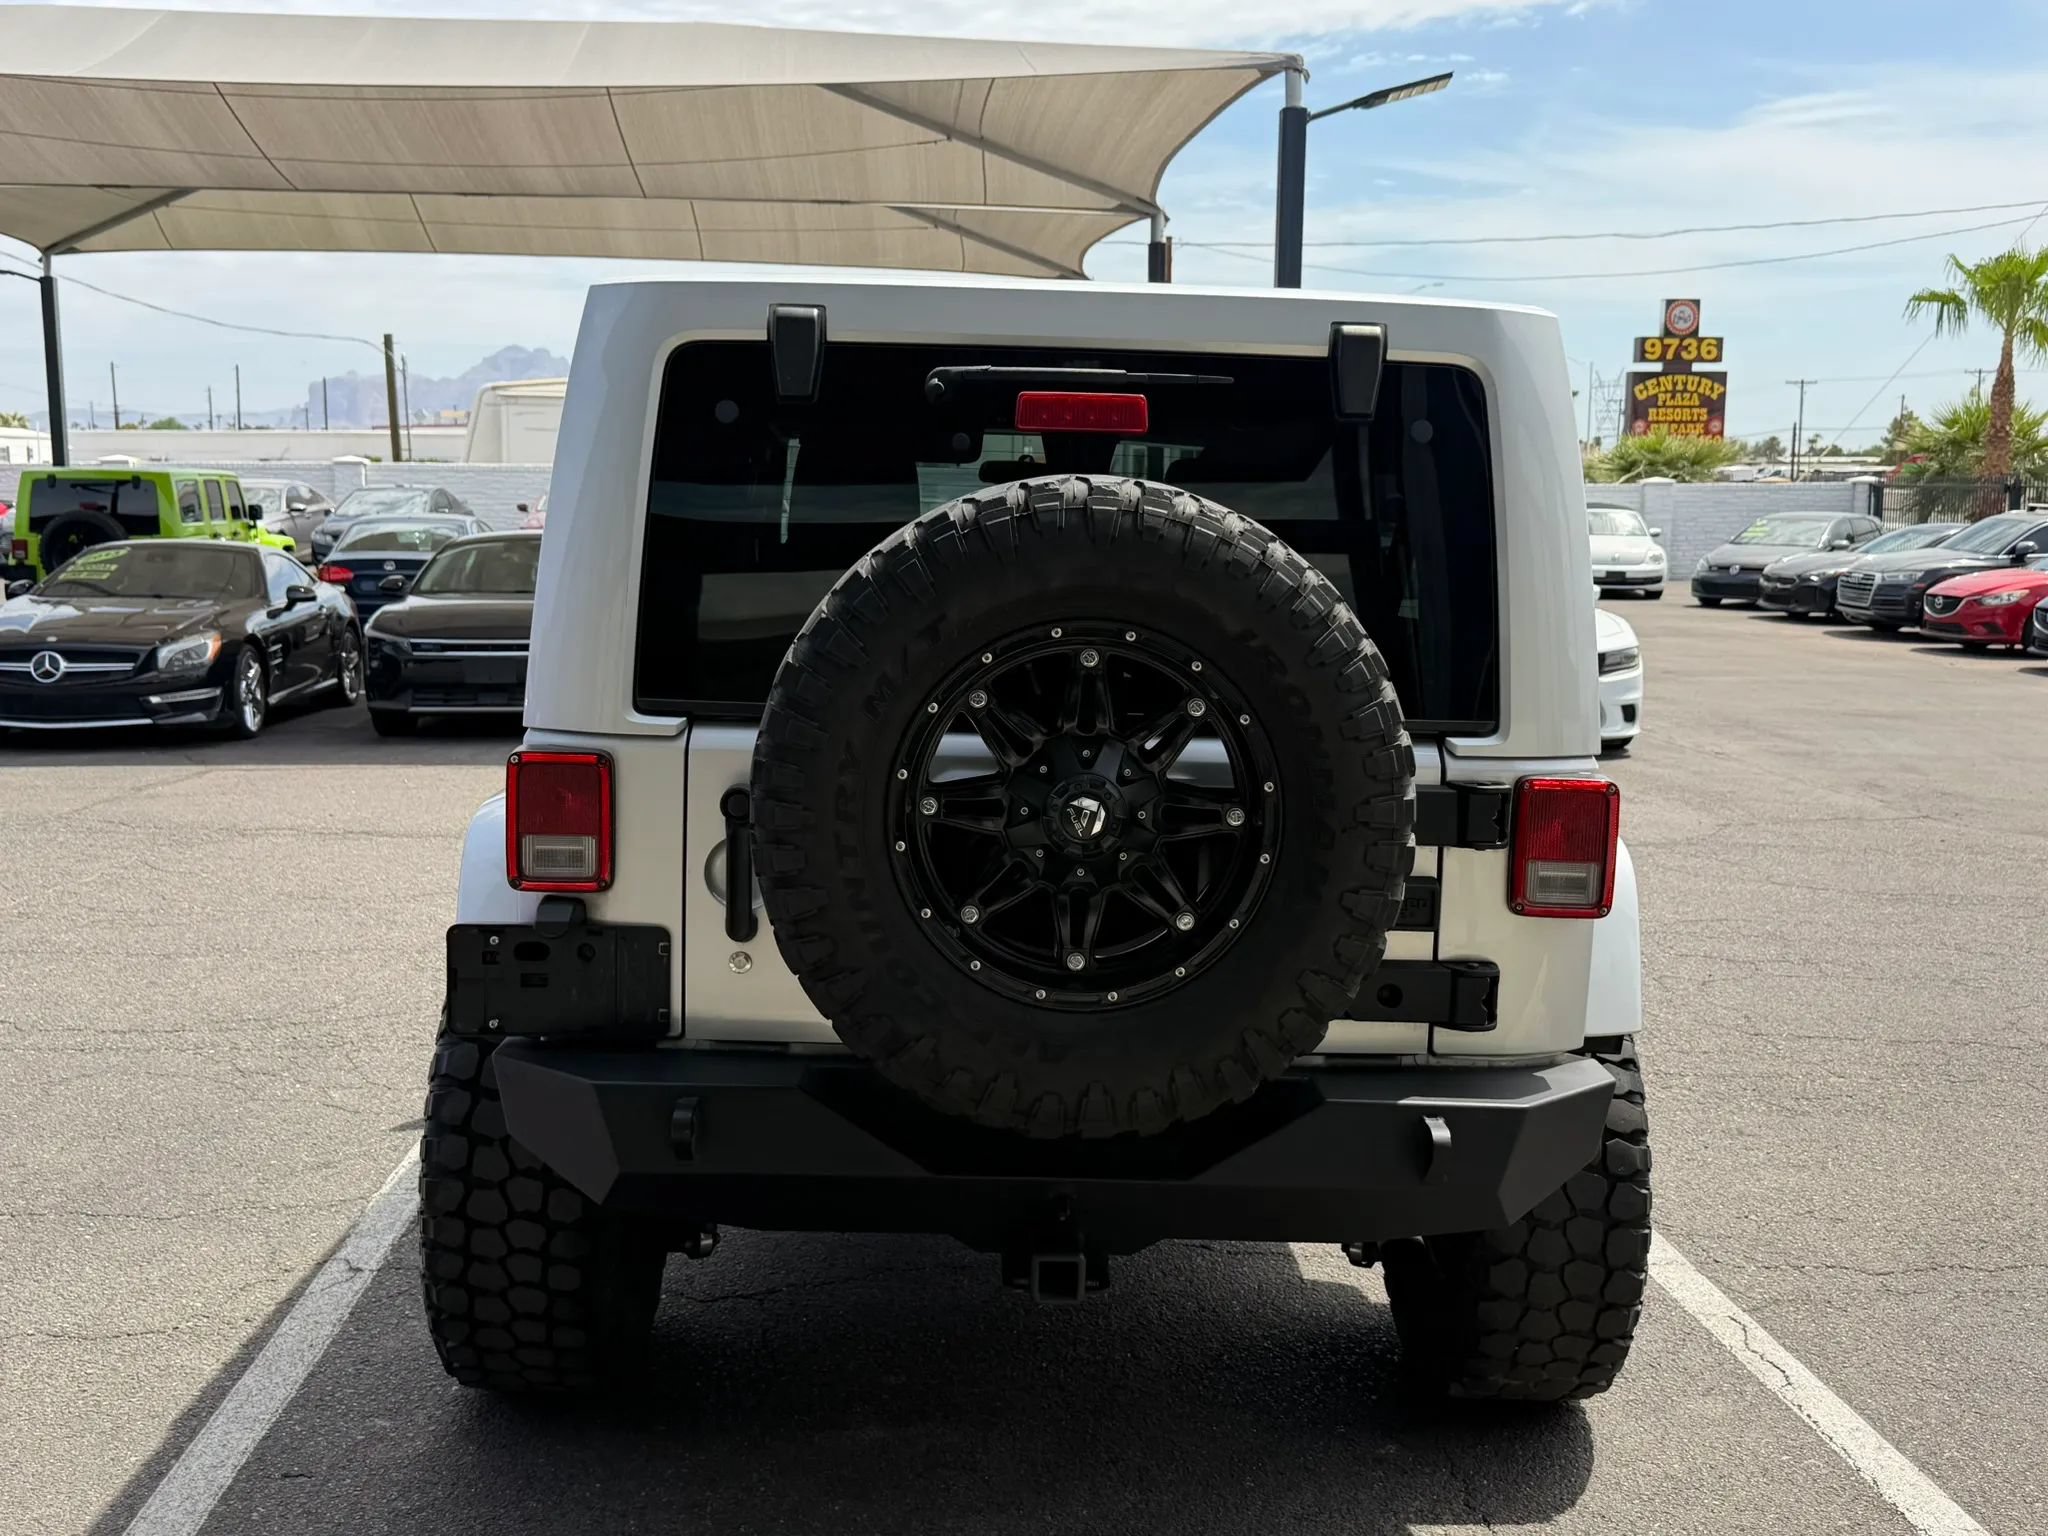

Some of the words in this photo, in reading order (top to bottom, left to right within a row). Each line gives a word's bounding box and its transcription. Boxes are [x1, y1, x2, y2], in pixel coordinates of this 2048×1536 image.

[1644, 338, 1718, 360] 9736
[1634, 375, 1724, 400] CENTURY
[1657, 393, 1700, 406] PLAZA
[1648, 407, 1708, 422] RESORTS
[1670, 423, 1705, 435] PARK
[859, 611, 955, 721] M/T
[1066, 807, 1083, 838] FUEL
